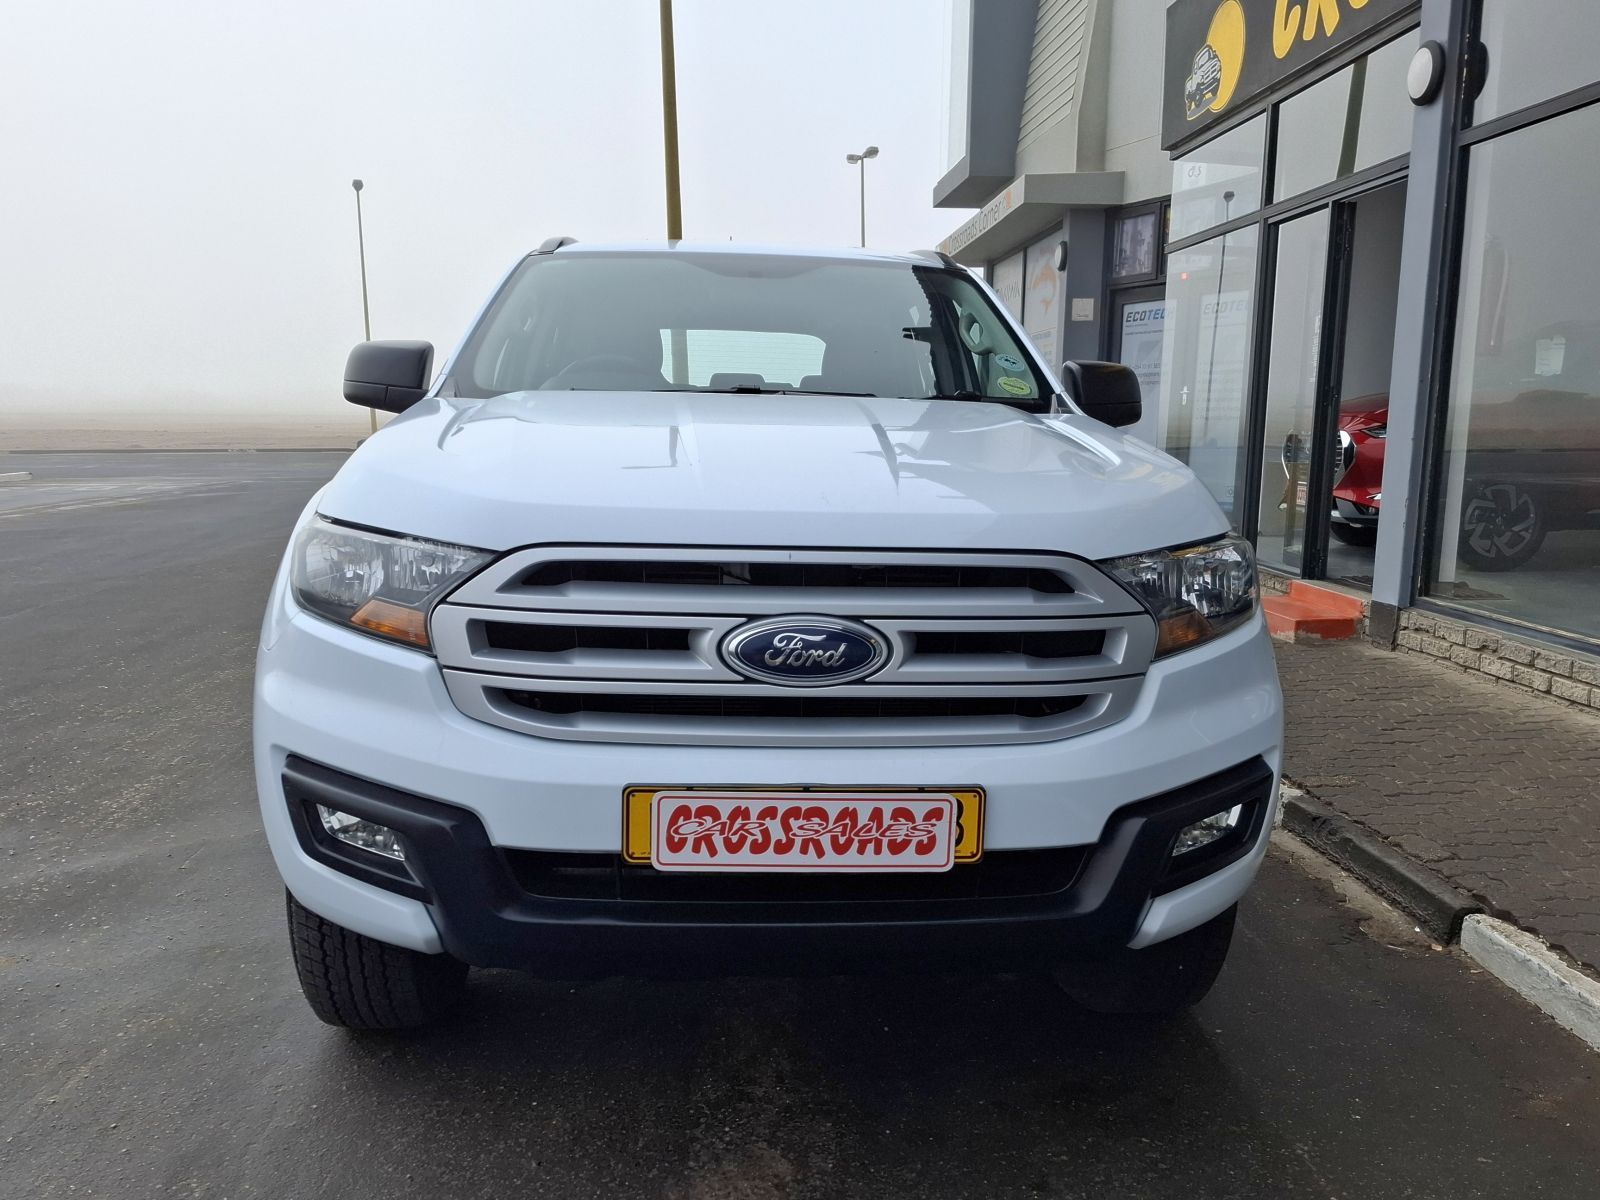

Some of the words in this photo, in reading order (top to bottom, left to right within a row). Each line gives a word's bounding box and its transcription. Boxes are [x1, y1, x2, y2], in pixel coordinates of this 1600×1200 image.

[979, 199, 1002, 233] Corner
[764, 632, 848, 667] Ford
[666, 804, 945, 860] CROSSROADS
[671, 819, 768, 839] CAR
[789, 819, 938, 841] SALES
